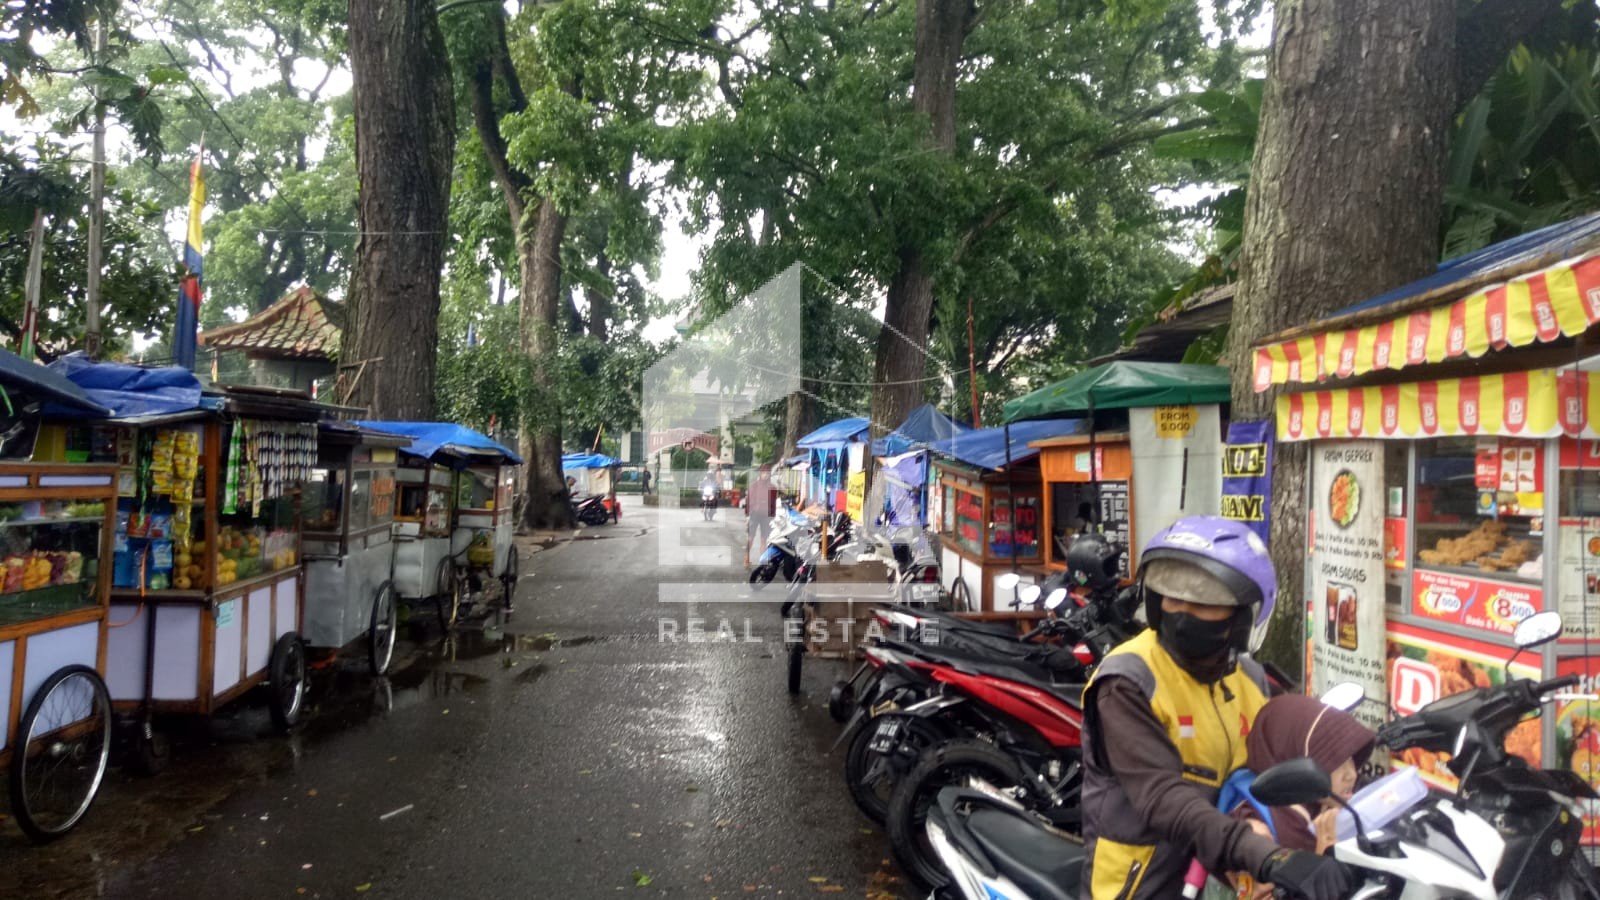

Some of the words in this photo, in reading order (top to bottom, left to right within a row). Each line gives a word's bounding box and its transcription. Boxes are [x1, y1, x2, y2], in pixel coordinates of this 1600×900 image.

[1160, 413, 1190, 421] FROM
[1497, 588, 1530, 600] Cuma
[1397, 668, 1434, 712] D
